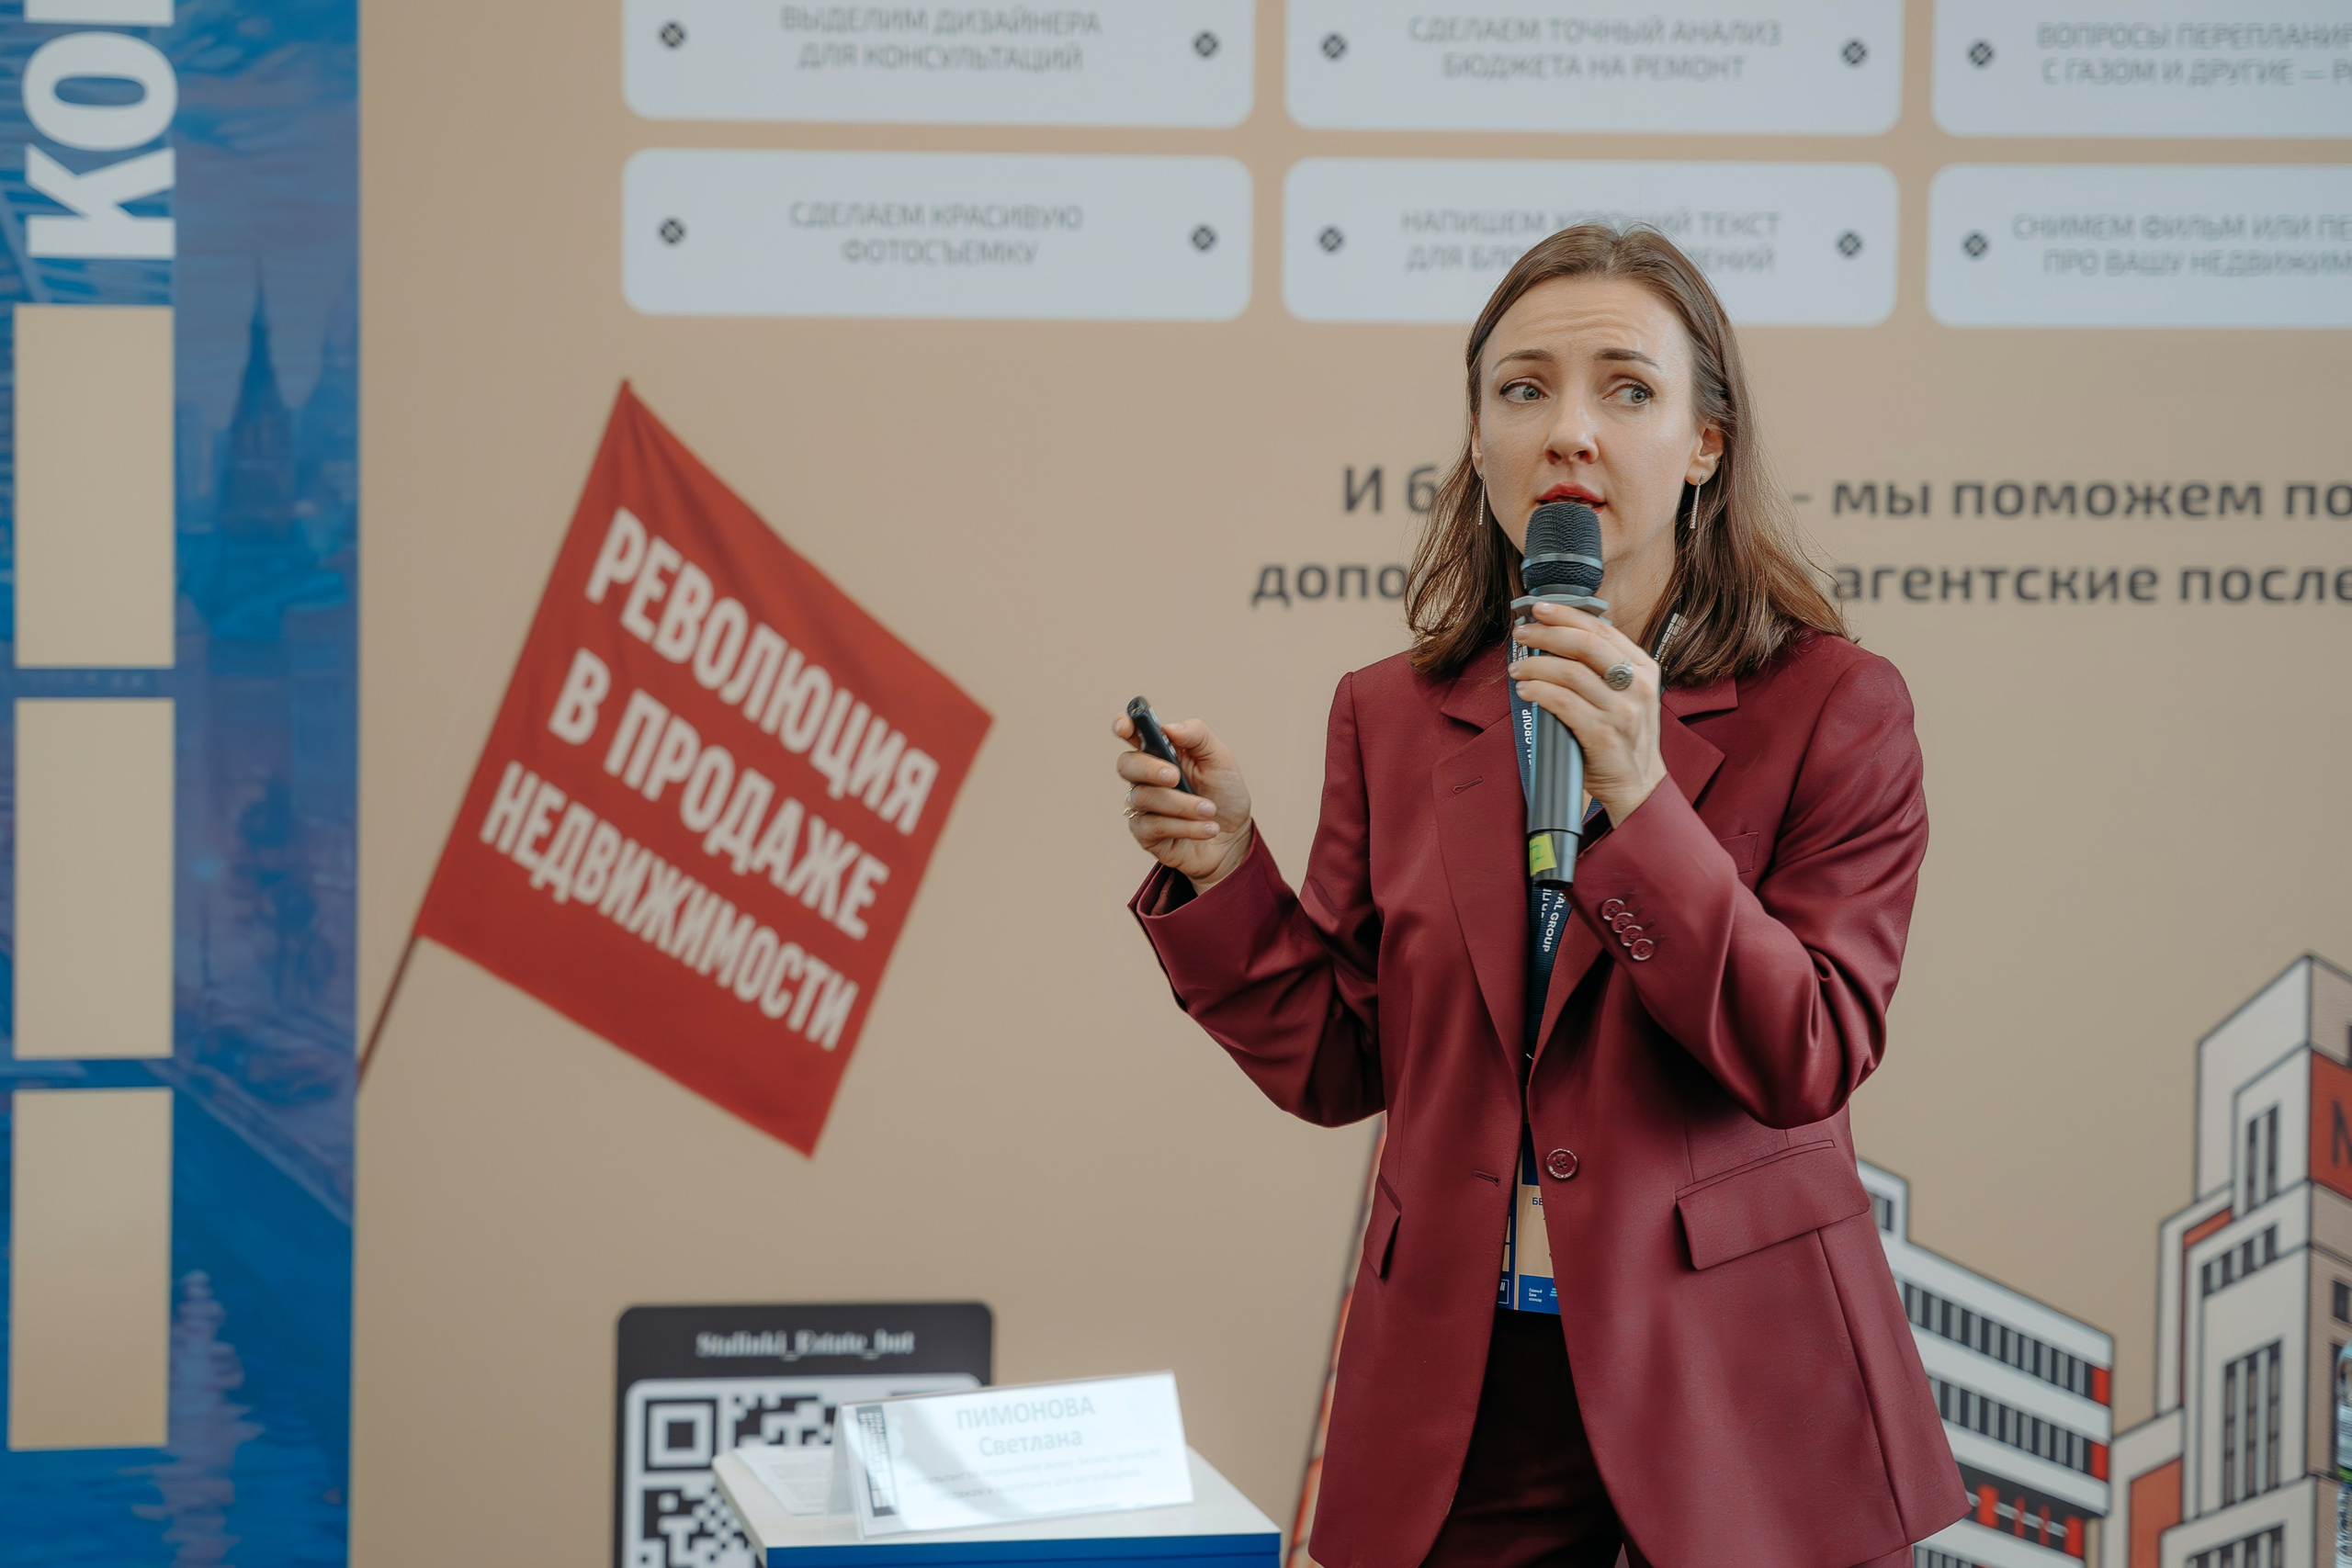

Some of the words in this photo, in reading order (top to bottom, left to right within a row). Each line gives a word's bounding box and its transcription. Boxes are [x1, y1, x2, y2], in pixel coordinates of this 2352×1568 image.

[782, 7, 926, 31] ВЫДЕЛИМ
[933, 6, 1102, 34] ДИЗАЙНЕРА
[1409, 17, 1540, 42] СДЕЛАЕМ
[1551, 16, 1664, 44] ТОЧНЫЙ
[1671, 20, 1781, 45] АНАЛИЗ
[2038, 23, 2170, 48] ВОПРОСЫ
[798, 44, 856, 69] ДЛЯ
[865, 43, 1082, 73] КОНСУЛЬТАЦИЙ
[1443, 53, 1580, 78] БЮДЖЕТА
[1589, 55, 1623, 78] НА
[1634, 55, 1746, 79] РЕМОНТ
[2042, 59, 2058, 84] С
[2066, 59, 2155, 84] ГАЗОМ
[2164, 59, 2182, 84] И
[2188, 59, 2292, 86] ДРУГИЕ
[790, 203, 922, 230] СДЕЛАЕМ
[932, 204, 1082, 230] КРАСИВУЮ
[1404, 211, 1544, 234] НАПИШЕМ
[1699, 212, 1781, 237] ТЕКСТ
[2014, 214, 2134, 239] СНИМЕМ
[2142, 214, 2245, 239] ФИЛЬМ
[2254, 214, 2310, 239] ИЛИ
[842, 240, 1038, 265] ФОТОСЪЕМКУ
[1407, 246, 1461, 271] ДЛЯ
[2045, 250, 2098, 275] ПРО
[2107, 250, 2184, 275] ВАШУ
[1344, 465, 1384, 513] И
[1833, 482, 1930, 516] мы
[1952, 480, 2262, 519] поможем
[1832, 565, 2159, 604] агентские
[583, 506, 940, 836] РЕВОЛЮЦИЯ
[548, 647, 612, 746] В
[602, 688, 891, 942] ПРОДАЖЕ
[479, 760, 861, 1053] НЕДВИЖИМОСТИ
[1543, 912, 1559, 953] GROUP
[956, 1395, 1096, 1430] ПИМОНОВА
[978, 1430, 1083, 1457] Светлана
